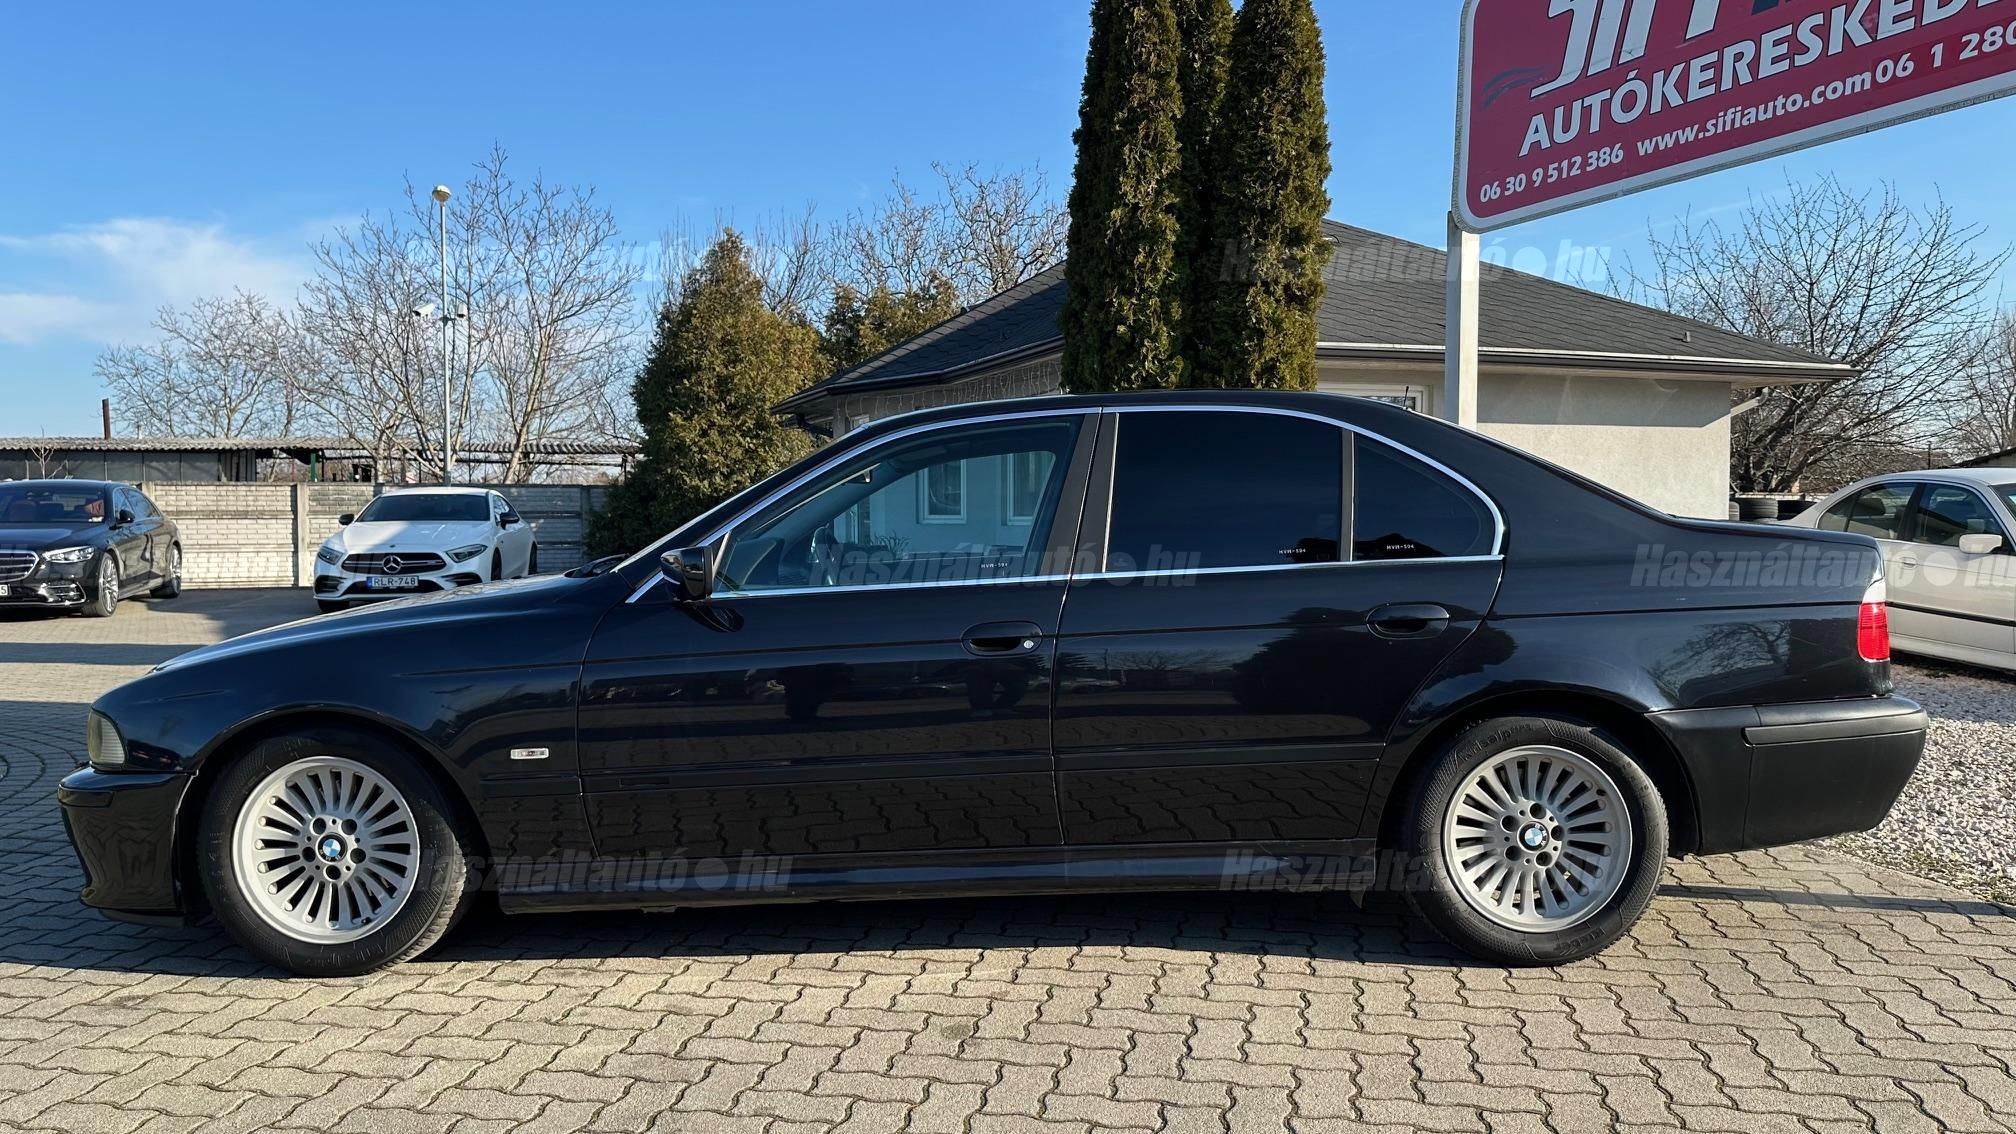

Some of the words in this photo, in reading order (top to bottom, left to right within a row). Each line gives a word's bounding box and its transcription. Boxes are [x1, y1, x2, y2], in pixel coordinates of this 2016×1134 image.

[1480, 181, 1501, 203] 06
[1504, 173, 1526, 196] 30
[1531, 167, 1544, 188] 9
[1547, 155, 1582, 183] 512
[1586, 142, 1624, 172] 386
[1636, 70, 1872, 157] www.sifiauto.com
[1875, 52, 1915, 84] 06
[1930, 42, 1944, 68] 1
[373, 577, 417, 586] RLR-748
